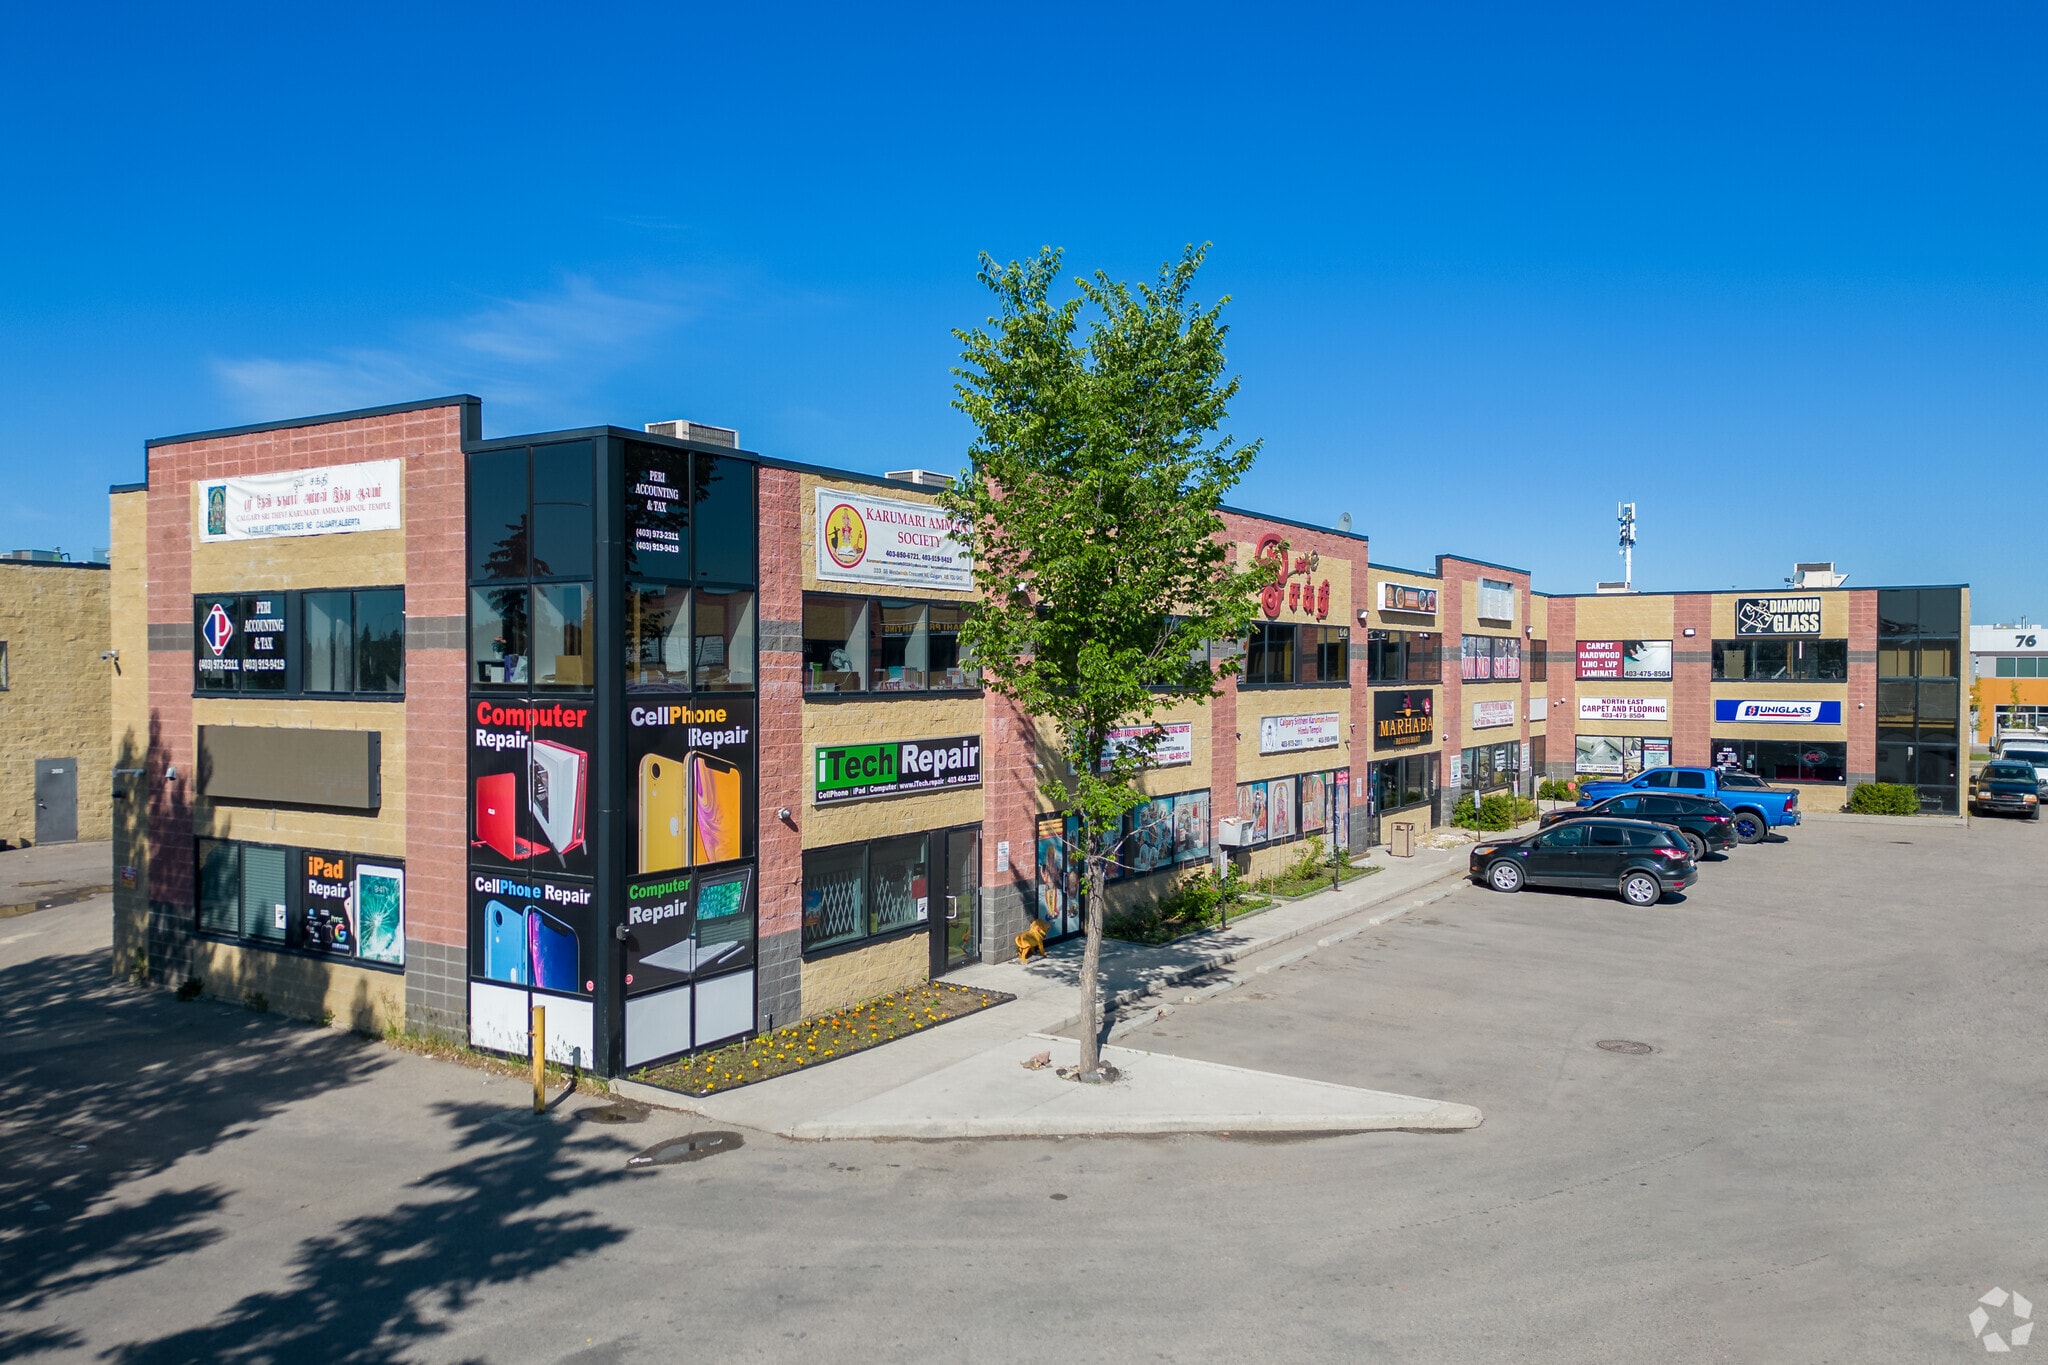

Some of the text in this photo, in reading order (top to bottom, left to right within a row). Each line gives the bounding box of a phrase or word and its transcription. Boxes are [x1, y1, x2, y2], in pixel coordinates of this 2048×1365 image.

[649, 470, 666, 482] PERI
[635, 483, 679, 500] ACCOUNTING
[322, 506, 344, 515] AMMAN
[346, 504, 366, 513] HINDU
[368, 502, 391, 511] TEMPLE
[647, 500, 667, 512] & TAX
[866, 507, 926, 528] KARUMARI
[636, 528, 679, 540] (403) 973-2311
[898, 531, 941, 548] SOCIETY
[636, 541, 679, 553] (403) 919-9419
[256, 601, 271, 614] PERI
[1770, 600, 1820, 612] DIAMOND
[244, 619, 284, 632] ACCOUNTING
[1773, 614, 1819, 632] GLASS
[260, 637, 273, 650] TAX
[1586, 642, 1614, 650] CARPET
[2015, 635, 2037, 647] 76
[199, 659, 239, 672] (403) 973-2311
[243, 659, 285, 672] (403) 919-9419
[1461, 657, 1520, 679] WIND SHIELD
[1582, 669, 1617, 677] LAMINATE
[476, 701, 587, 732] Computer
[630, 706, 727, 726] CellPhone
[1612, 705, 1627, 713] AND
[1629, 705, 1666, 713] FLOORING
[1309, 725, 1322, 735] Temple
[1379, 716, 1433, 737] MARHABA
[476, 728, 528, 751] Repair
[688, 726, 749, 749] Repair
[819, 740, 979, 783] iTech Repair
[818, 790, 849, 799] CellPhone
[853, 786, 866, 795] iPad
[869, 784, 897, 793] Computer
[947, 776, 957, 784] 403
[957, 775, 967, 783] 454
[308, 856, 344, 879] iPad
[308, 879, 347, 899] Repair
[475, 876, 591, 905] CellPhone Repair
[629, 878, 691, 900] Computer
[629, 899, 687, 925] Repair
